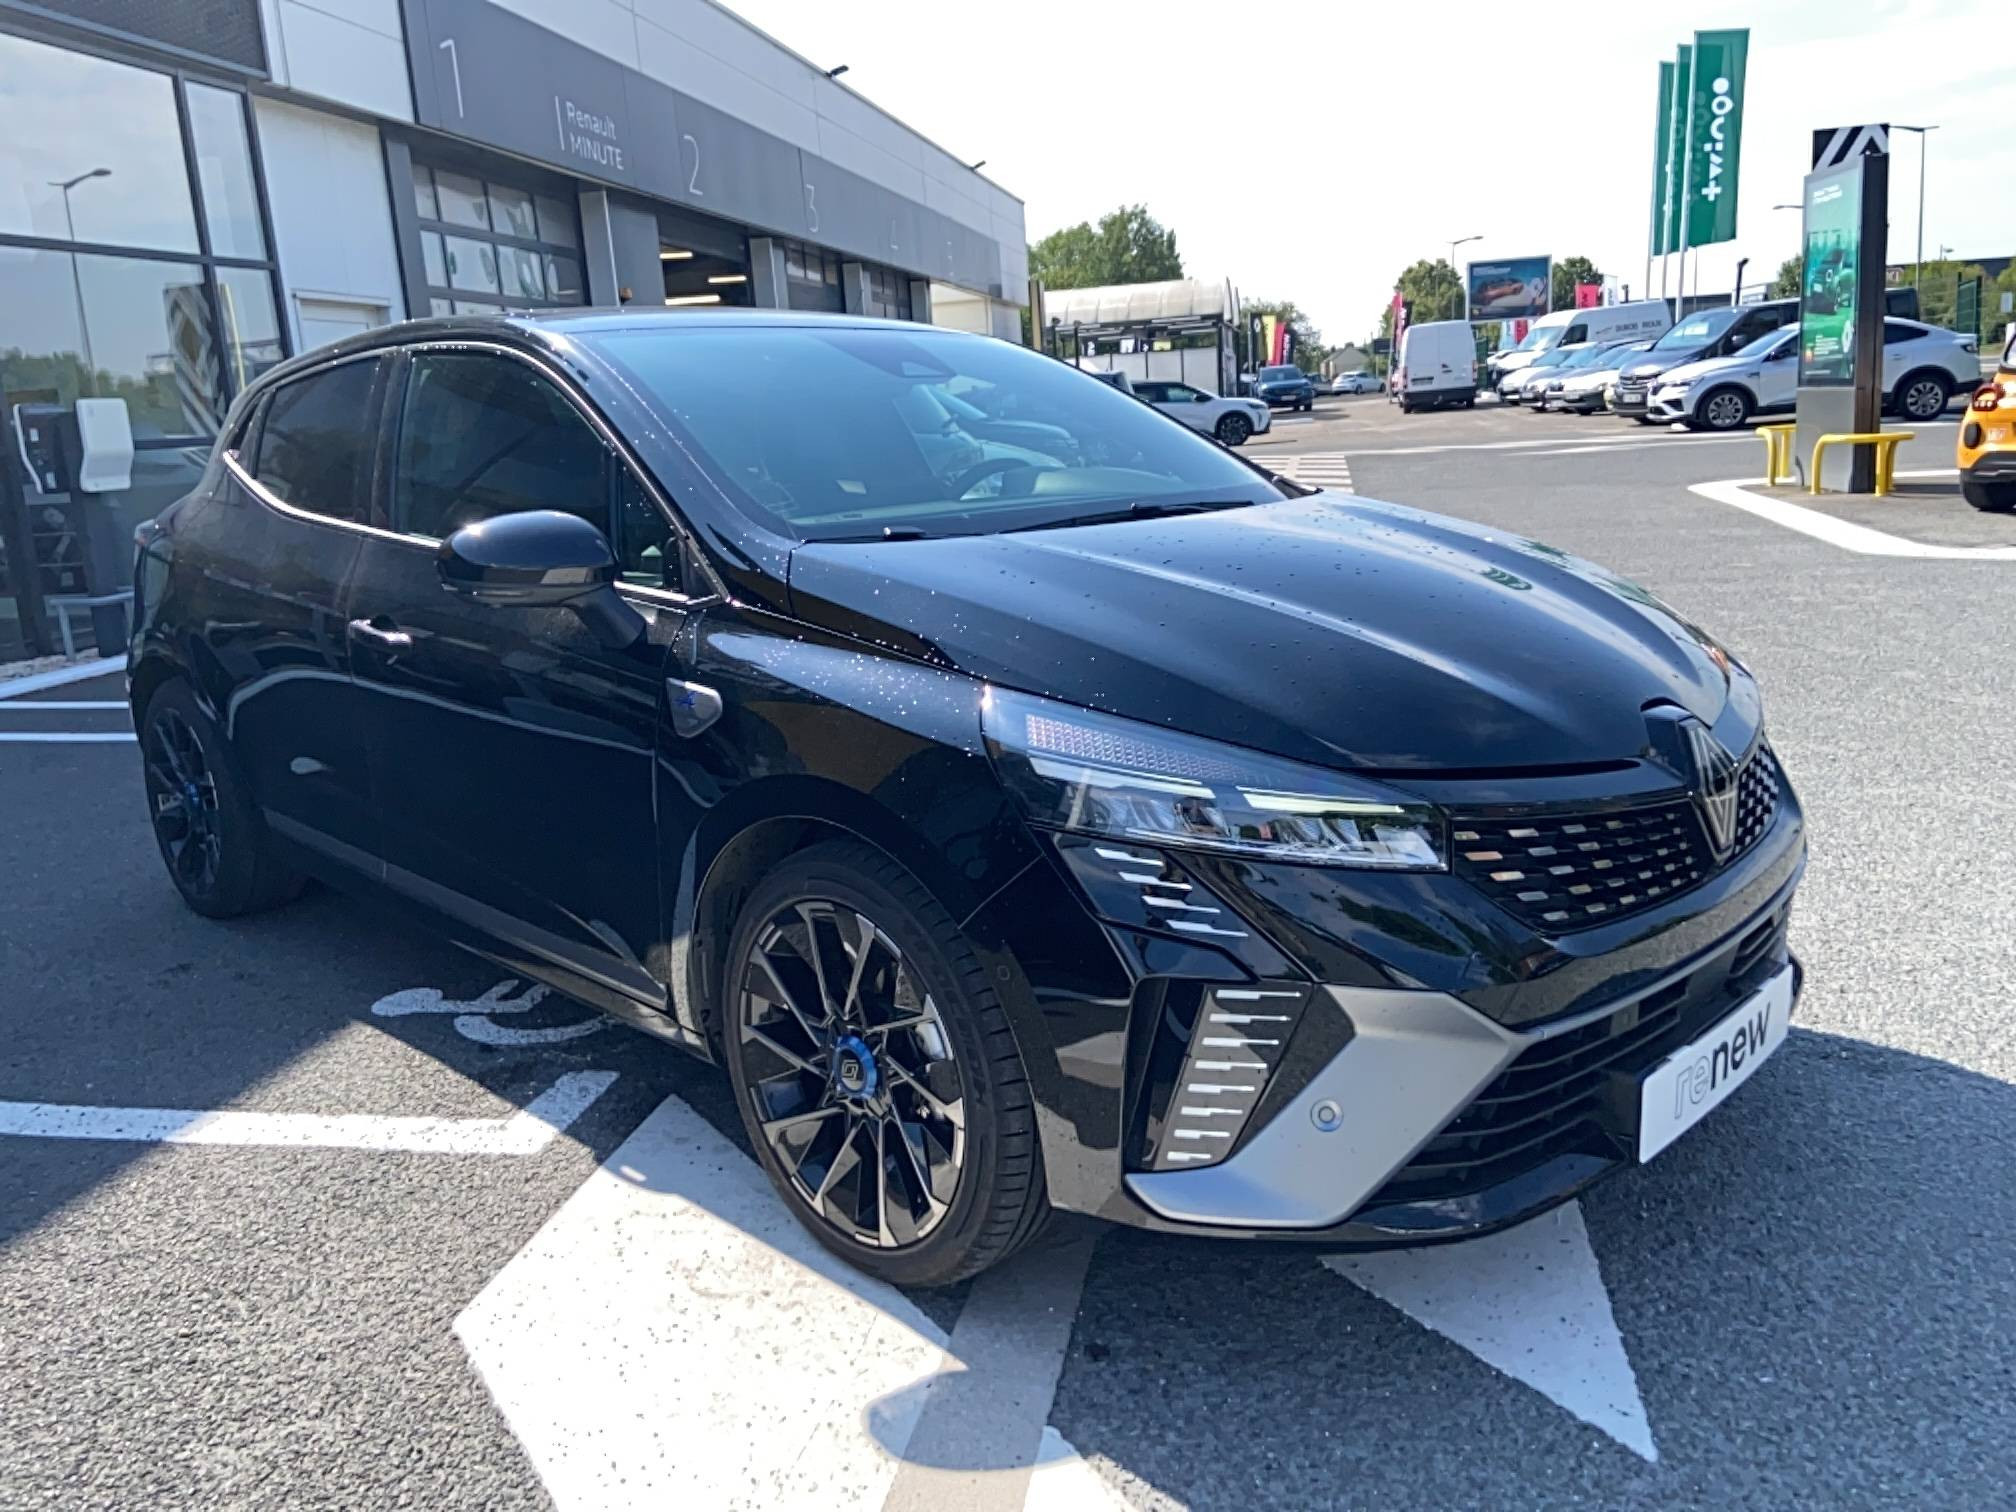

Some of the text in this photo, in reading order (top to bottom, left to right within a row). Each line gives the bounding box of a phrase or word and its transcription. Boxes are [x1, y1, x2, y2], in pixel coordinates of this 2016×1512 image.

[439, 38, 464, 118] 1
[565, 100, 617, 140] Renault
[569, 131, 625, 170] MINUTE
[683, 134, 704, 196] 2
[806, 183, 818, 232] 3
[1673, 1001, 1771, 1120] renew
